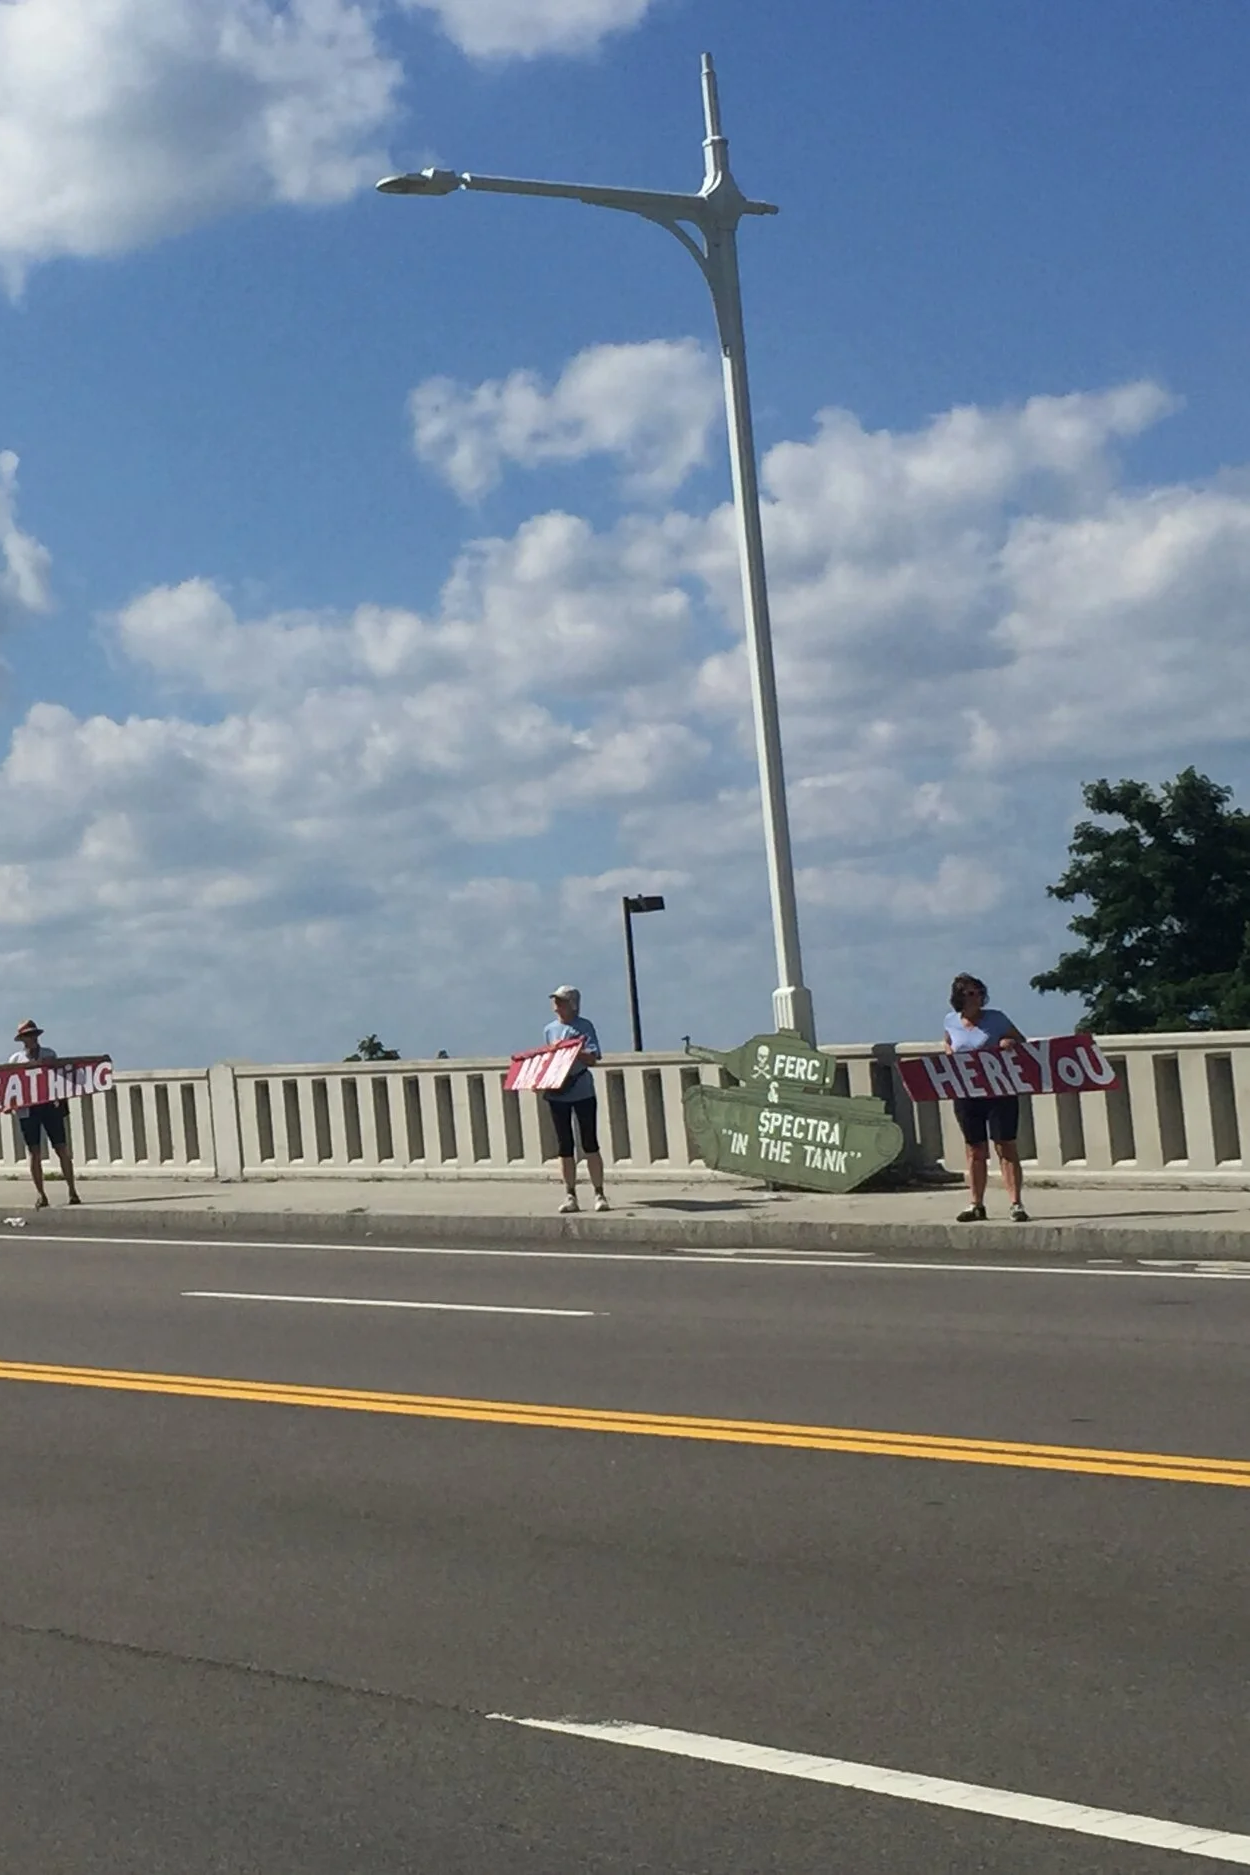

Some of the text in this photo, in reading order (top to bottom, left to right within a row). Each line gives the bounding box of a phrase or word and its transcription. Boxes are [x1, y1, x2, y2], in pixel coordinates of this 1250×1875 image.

[773, 1054, 821, 1081] FERC
[922, 1050, 1035, 1098] HERE
[767, 1081, 779, 1103] &
[758, 1136, 792, 1164] THE
